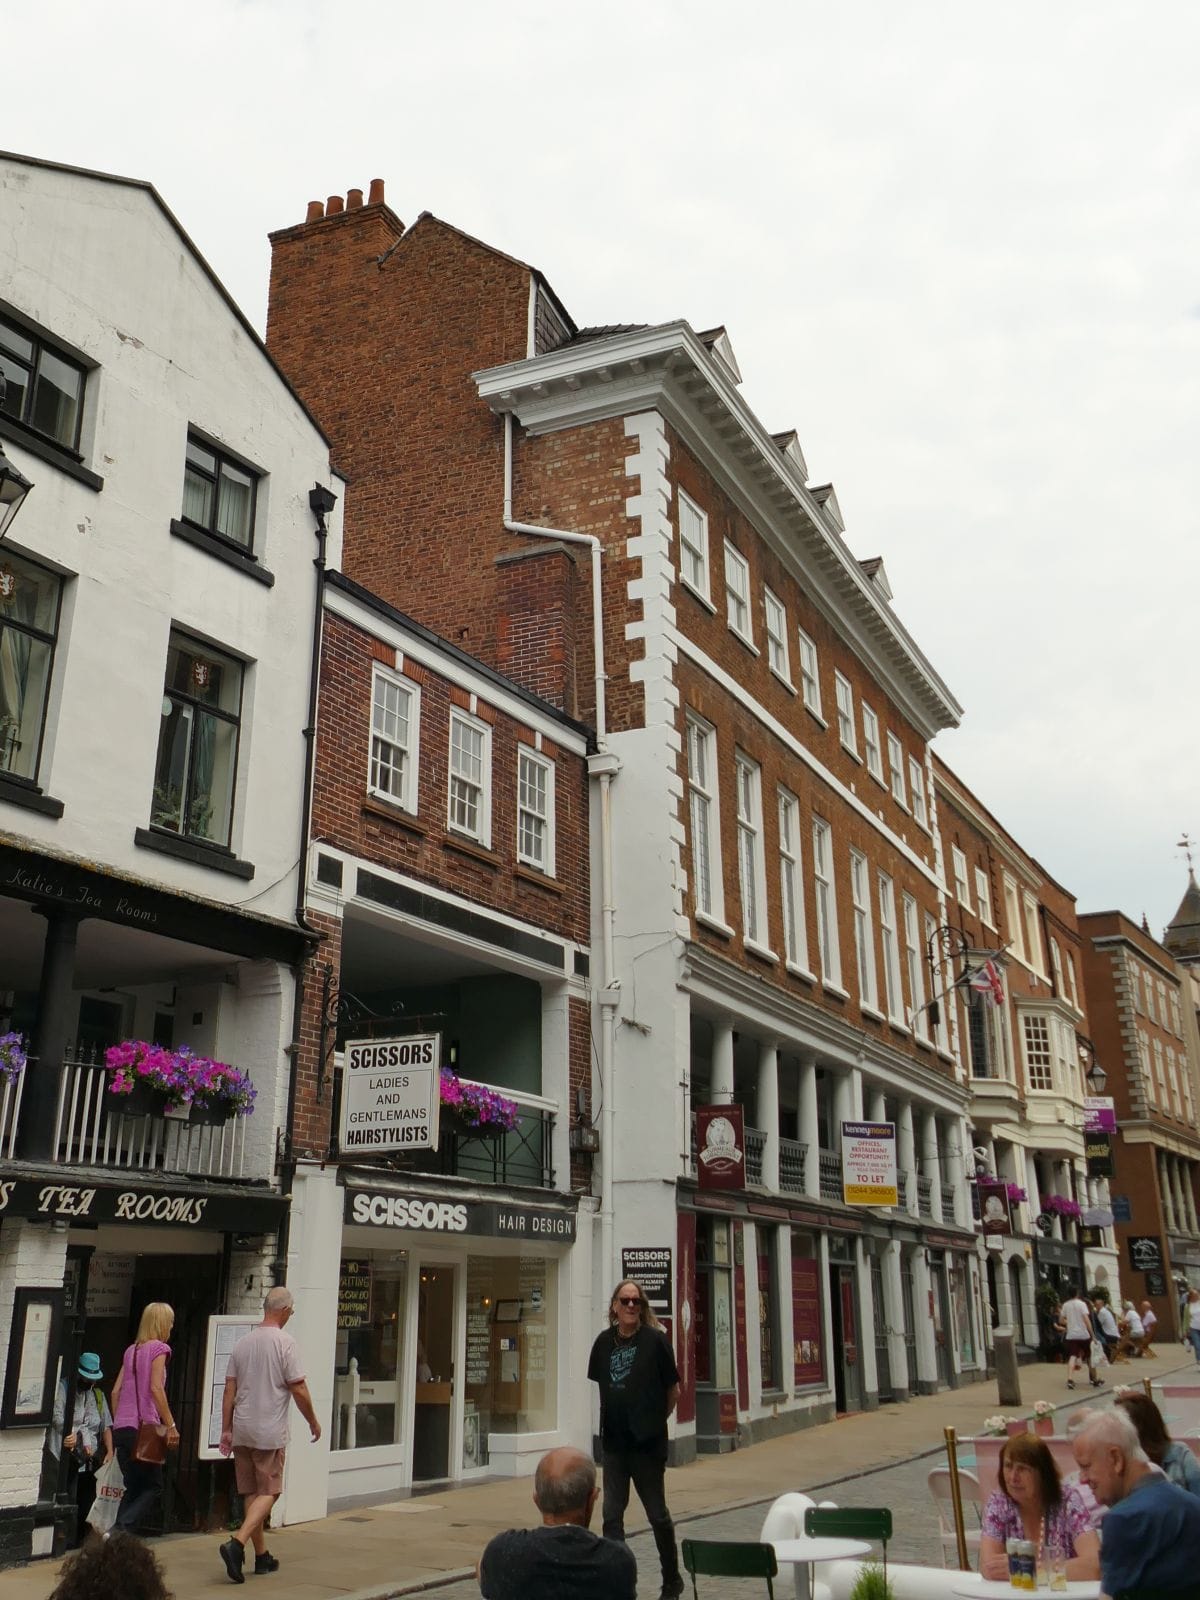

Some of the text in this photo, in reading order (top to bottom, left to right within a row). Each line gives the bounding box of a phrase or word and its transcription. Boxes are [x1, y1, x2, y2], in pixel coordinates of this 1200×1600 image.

[6, 868, 157, 922] Katie's Tea Rooms
[350, 1043, 433, 1069] SCISSORS
[369, 1076, 410, 1090] LADIES
[376, 1093, 401, 1106] AND
[349, 1107, 427, 1124] GENTLEMANS
[346, 1125, 428, 1146] HAIRSTYLISTS
[845, 1124, 891, 1136] kenneymoore
[857, 1174, 885, 1183] TO LET
[38, 1186, 96, 1216] TEA
[115, 1192, 207, 1224] ROOMS
[352, 1193, 468, 1231] SCISSORS
[499, 1214, 571, 1234] HAIR DESIGN
[623, 1251, 671, 1260] SCISSORS
